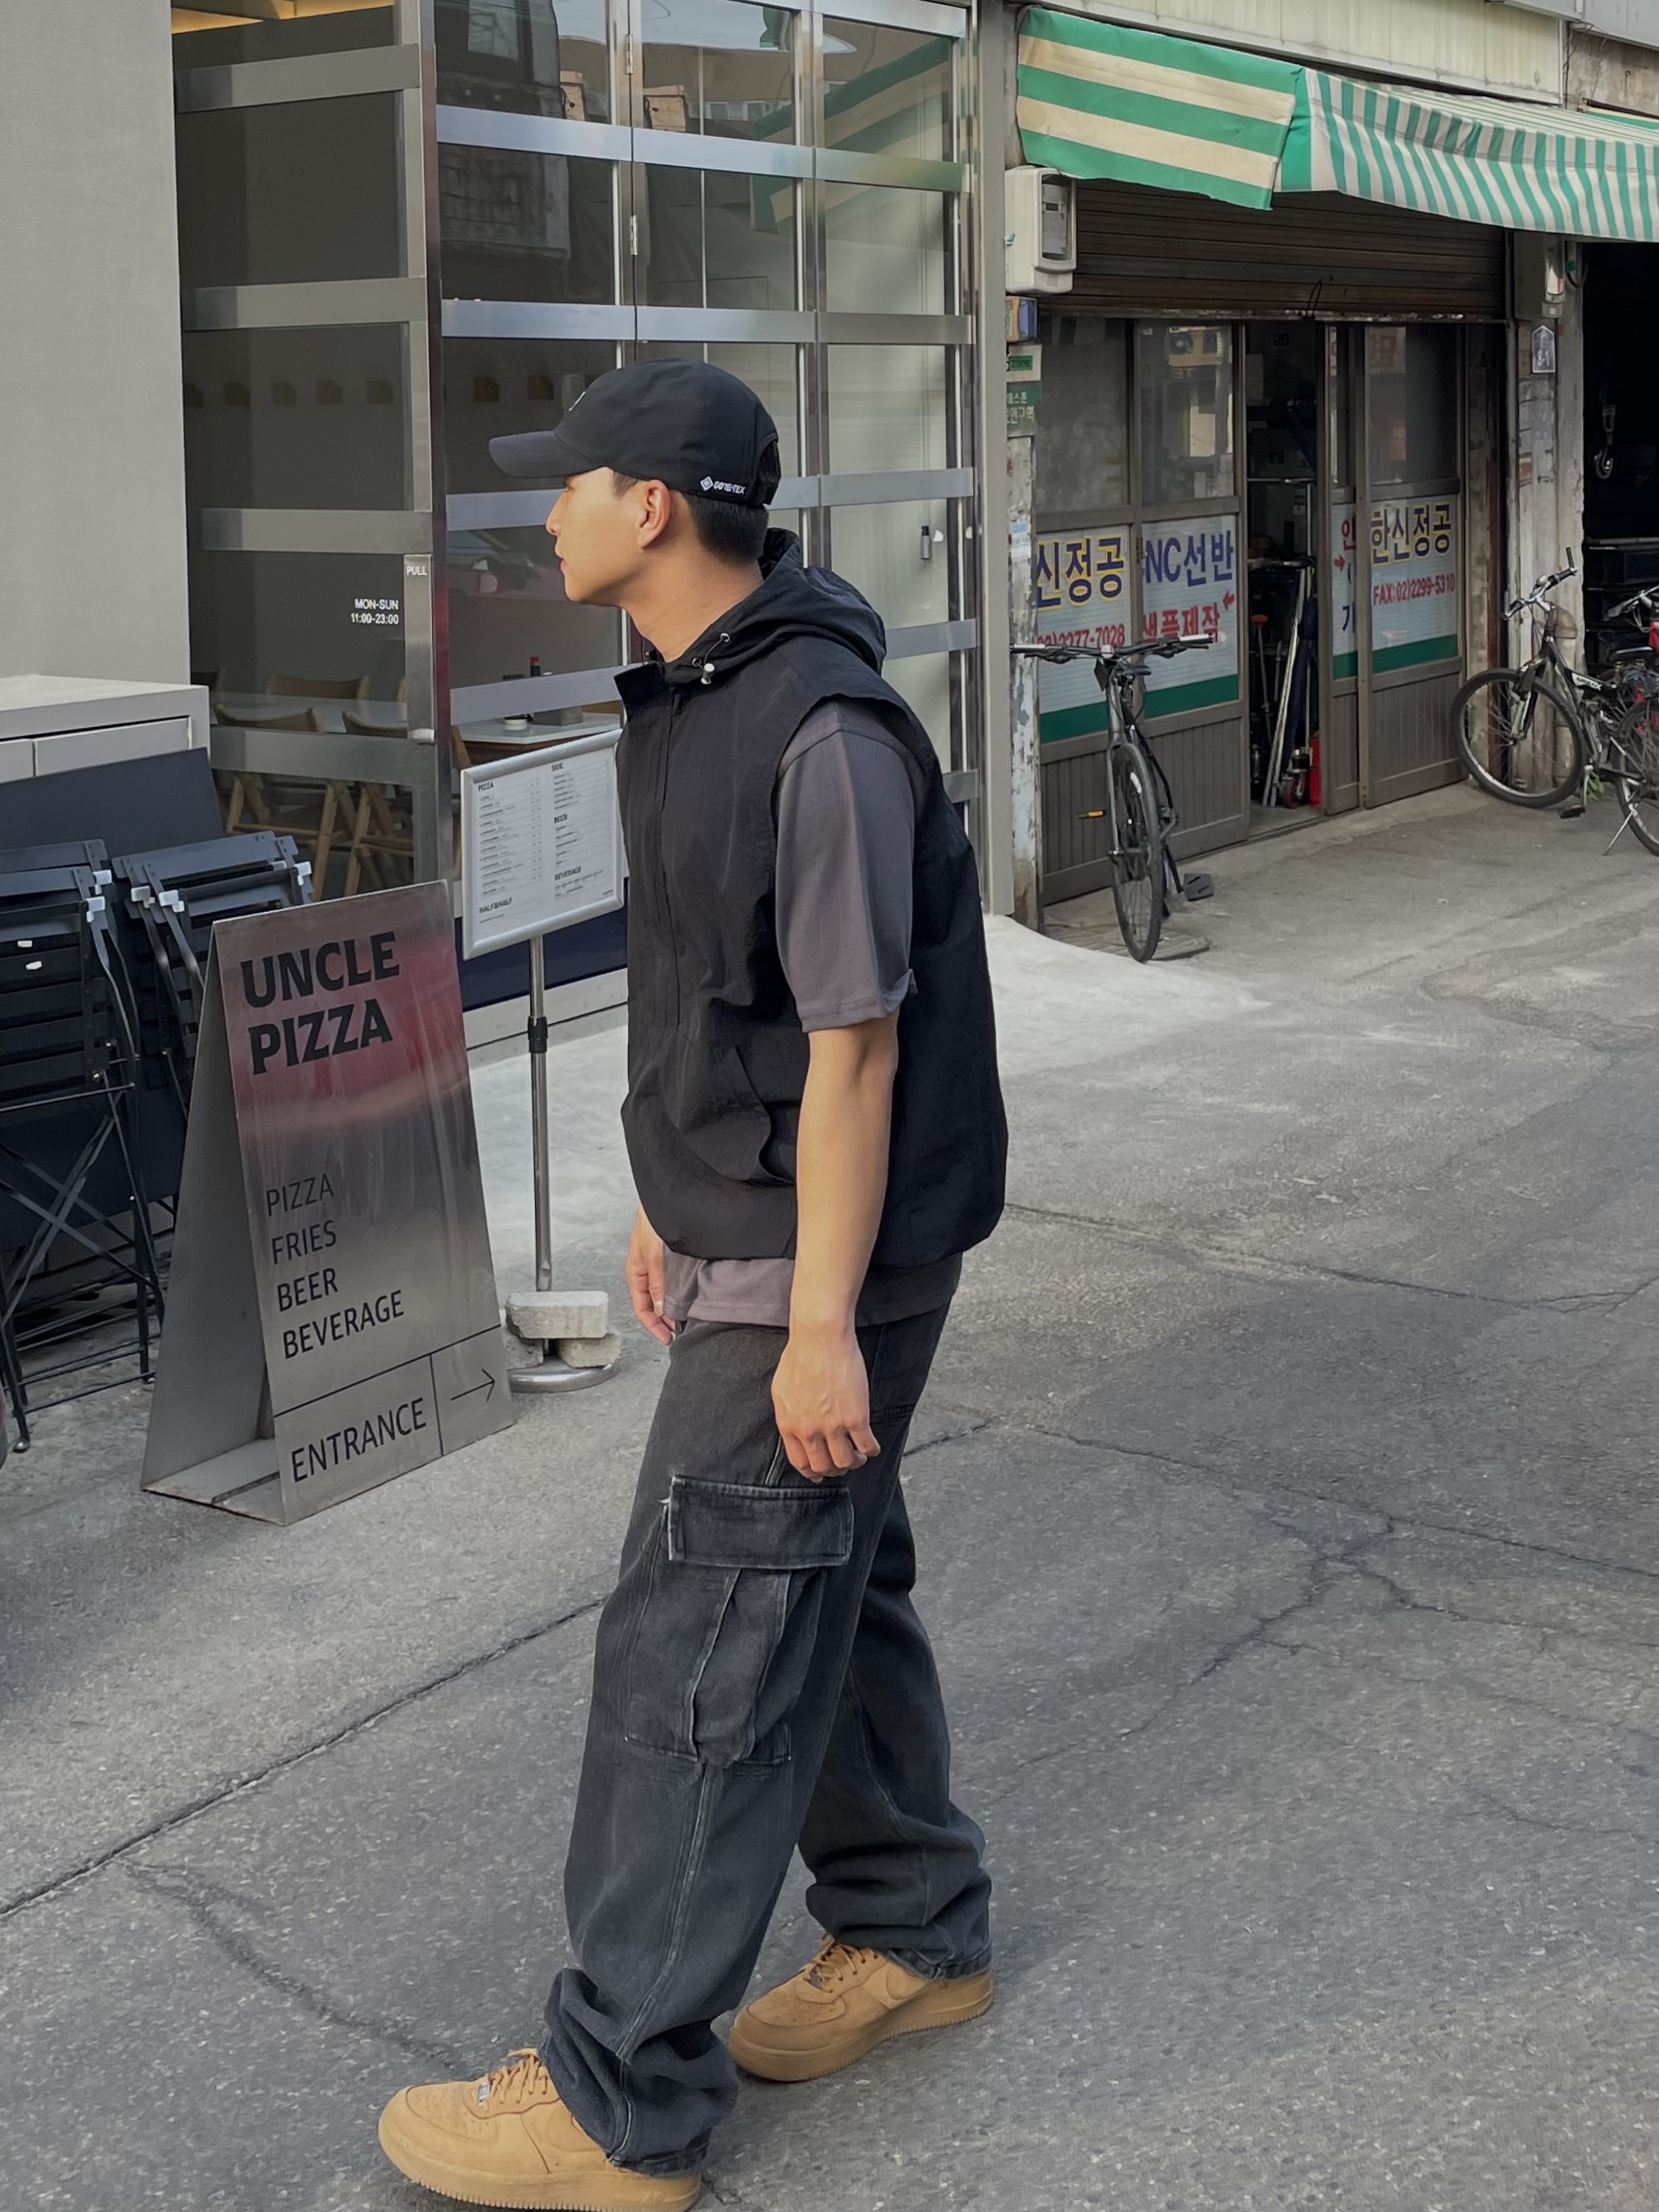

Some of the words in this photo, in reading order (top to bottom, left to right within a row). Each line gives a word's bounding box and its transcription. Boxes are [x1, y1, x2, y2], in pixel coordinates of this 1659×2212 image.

[1370, 504, 1452, 564] 한신정공
[406, 566, 428, 576] PULL
[351, 613, 399, 624] 11:00-23:00
[354, 598, 399, 610] MON-SUN
[478, 781, 494, 792] PIZZA
[240, 931, 400, 1008] UNCLE
[247, 999, 393, 1076] PIZZA
[266, 1173, 335, 1217] PIZZA
[271, 1219, 337, 1266] FRIES
[277, 1268, 338, 1313] BEER
[282, 1289, 404, 1359] BEVERAGE
[291, 1397, 427, 1483] ENTRANCE
